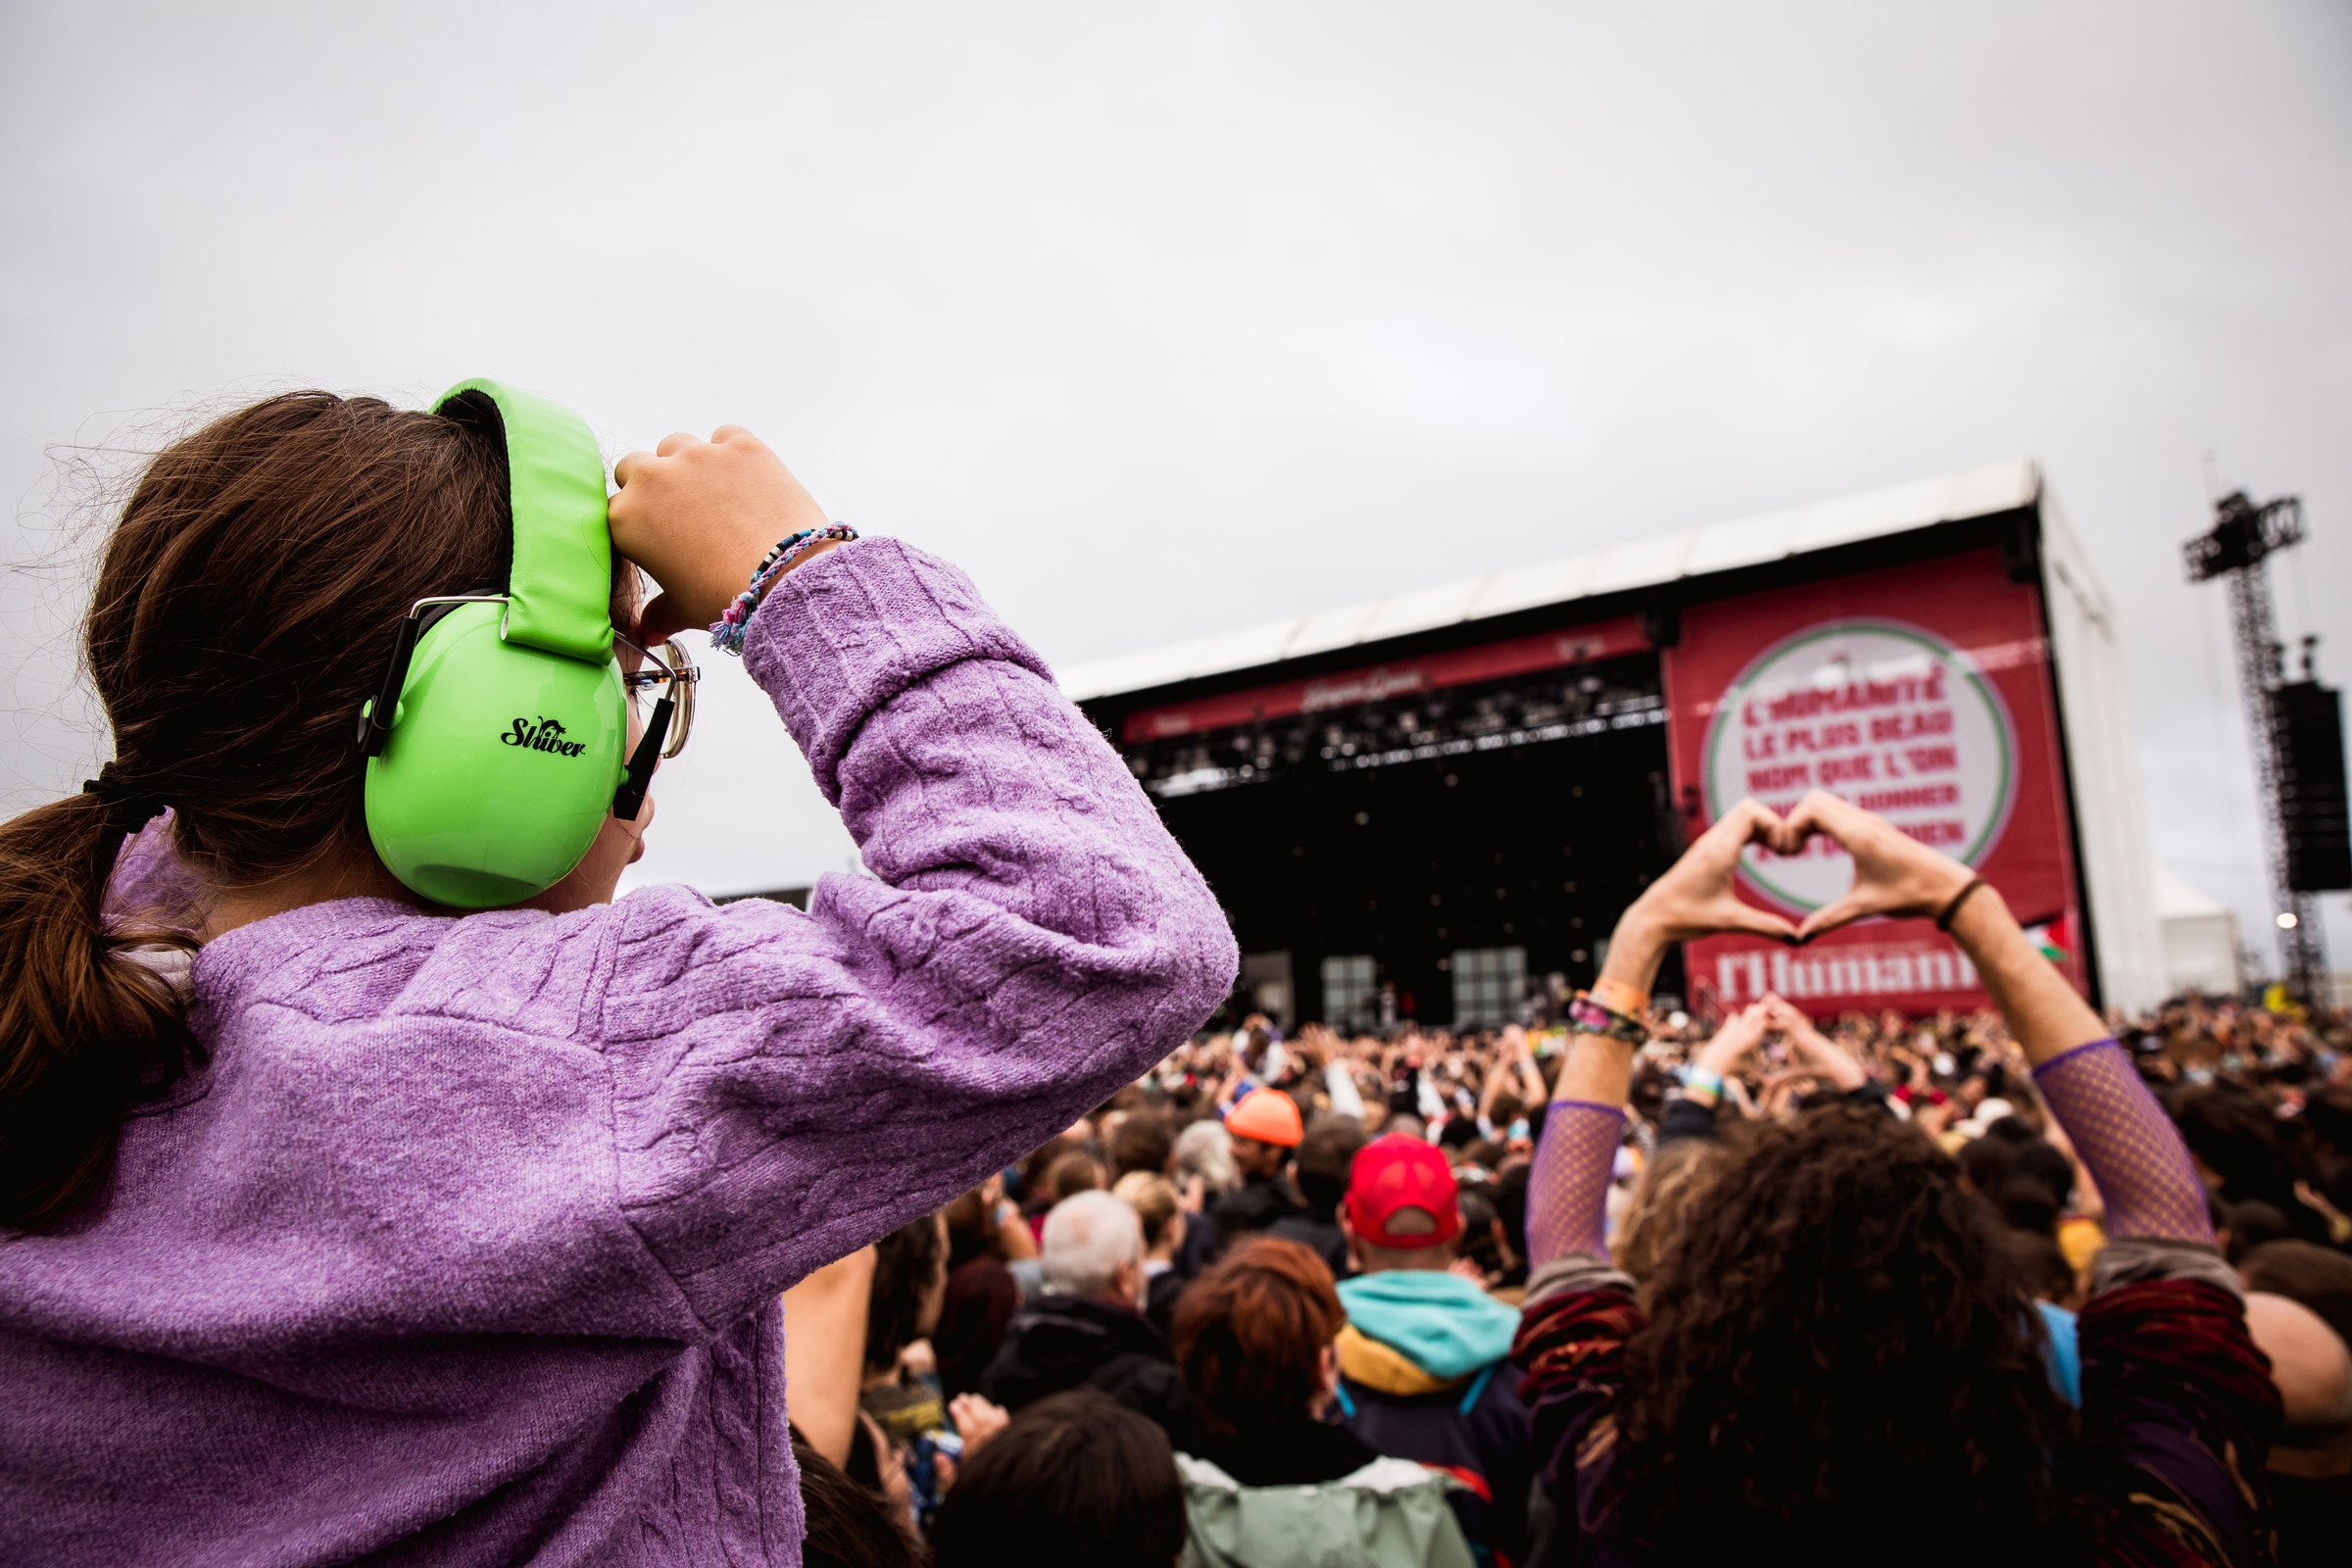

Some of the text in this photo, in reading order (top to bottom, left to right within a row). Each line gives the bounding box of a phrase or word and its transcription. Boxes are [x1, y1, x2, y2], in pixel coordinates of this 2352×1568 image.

[501, 715, 586, 758] Shiver
[1744, 710, 1954, 760] LE PLUS BEAU
[1747, 764, 1810, 793] NOM
[1818, 754, 1873, 788] QUE
